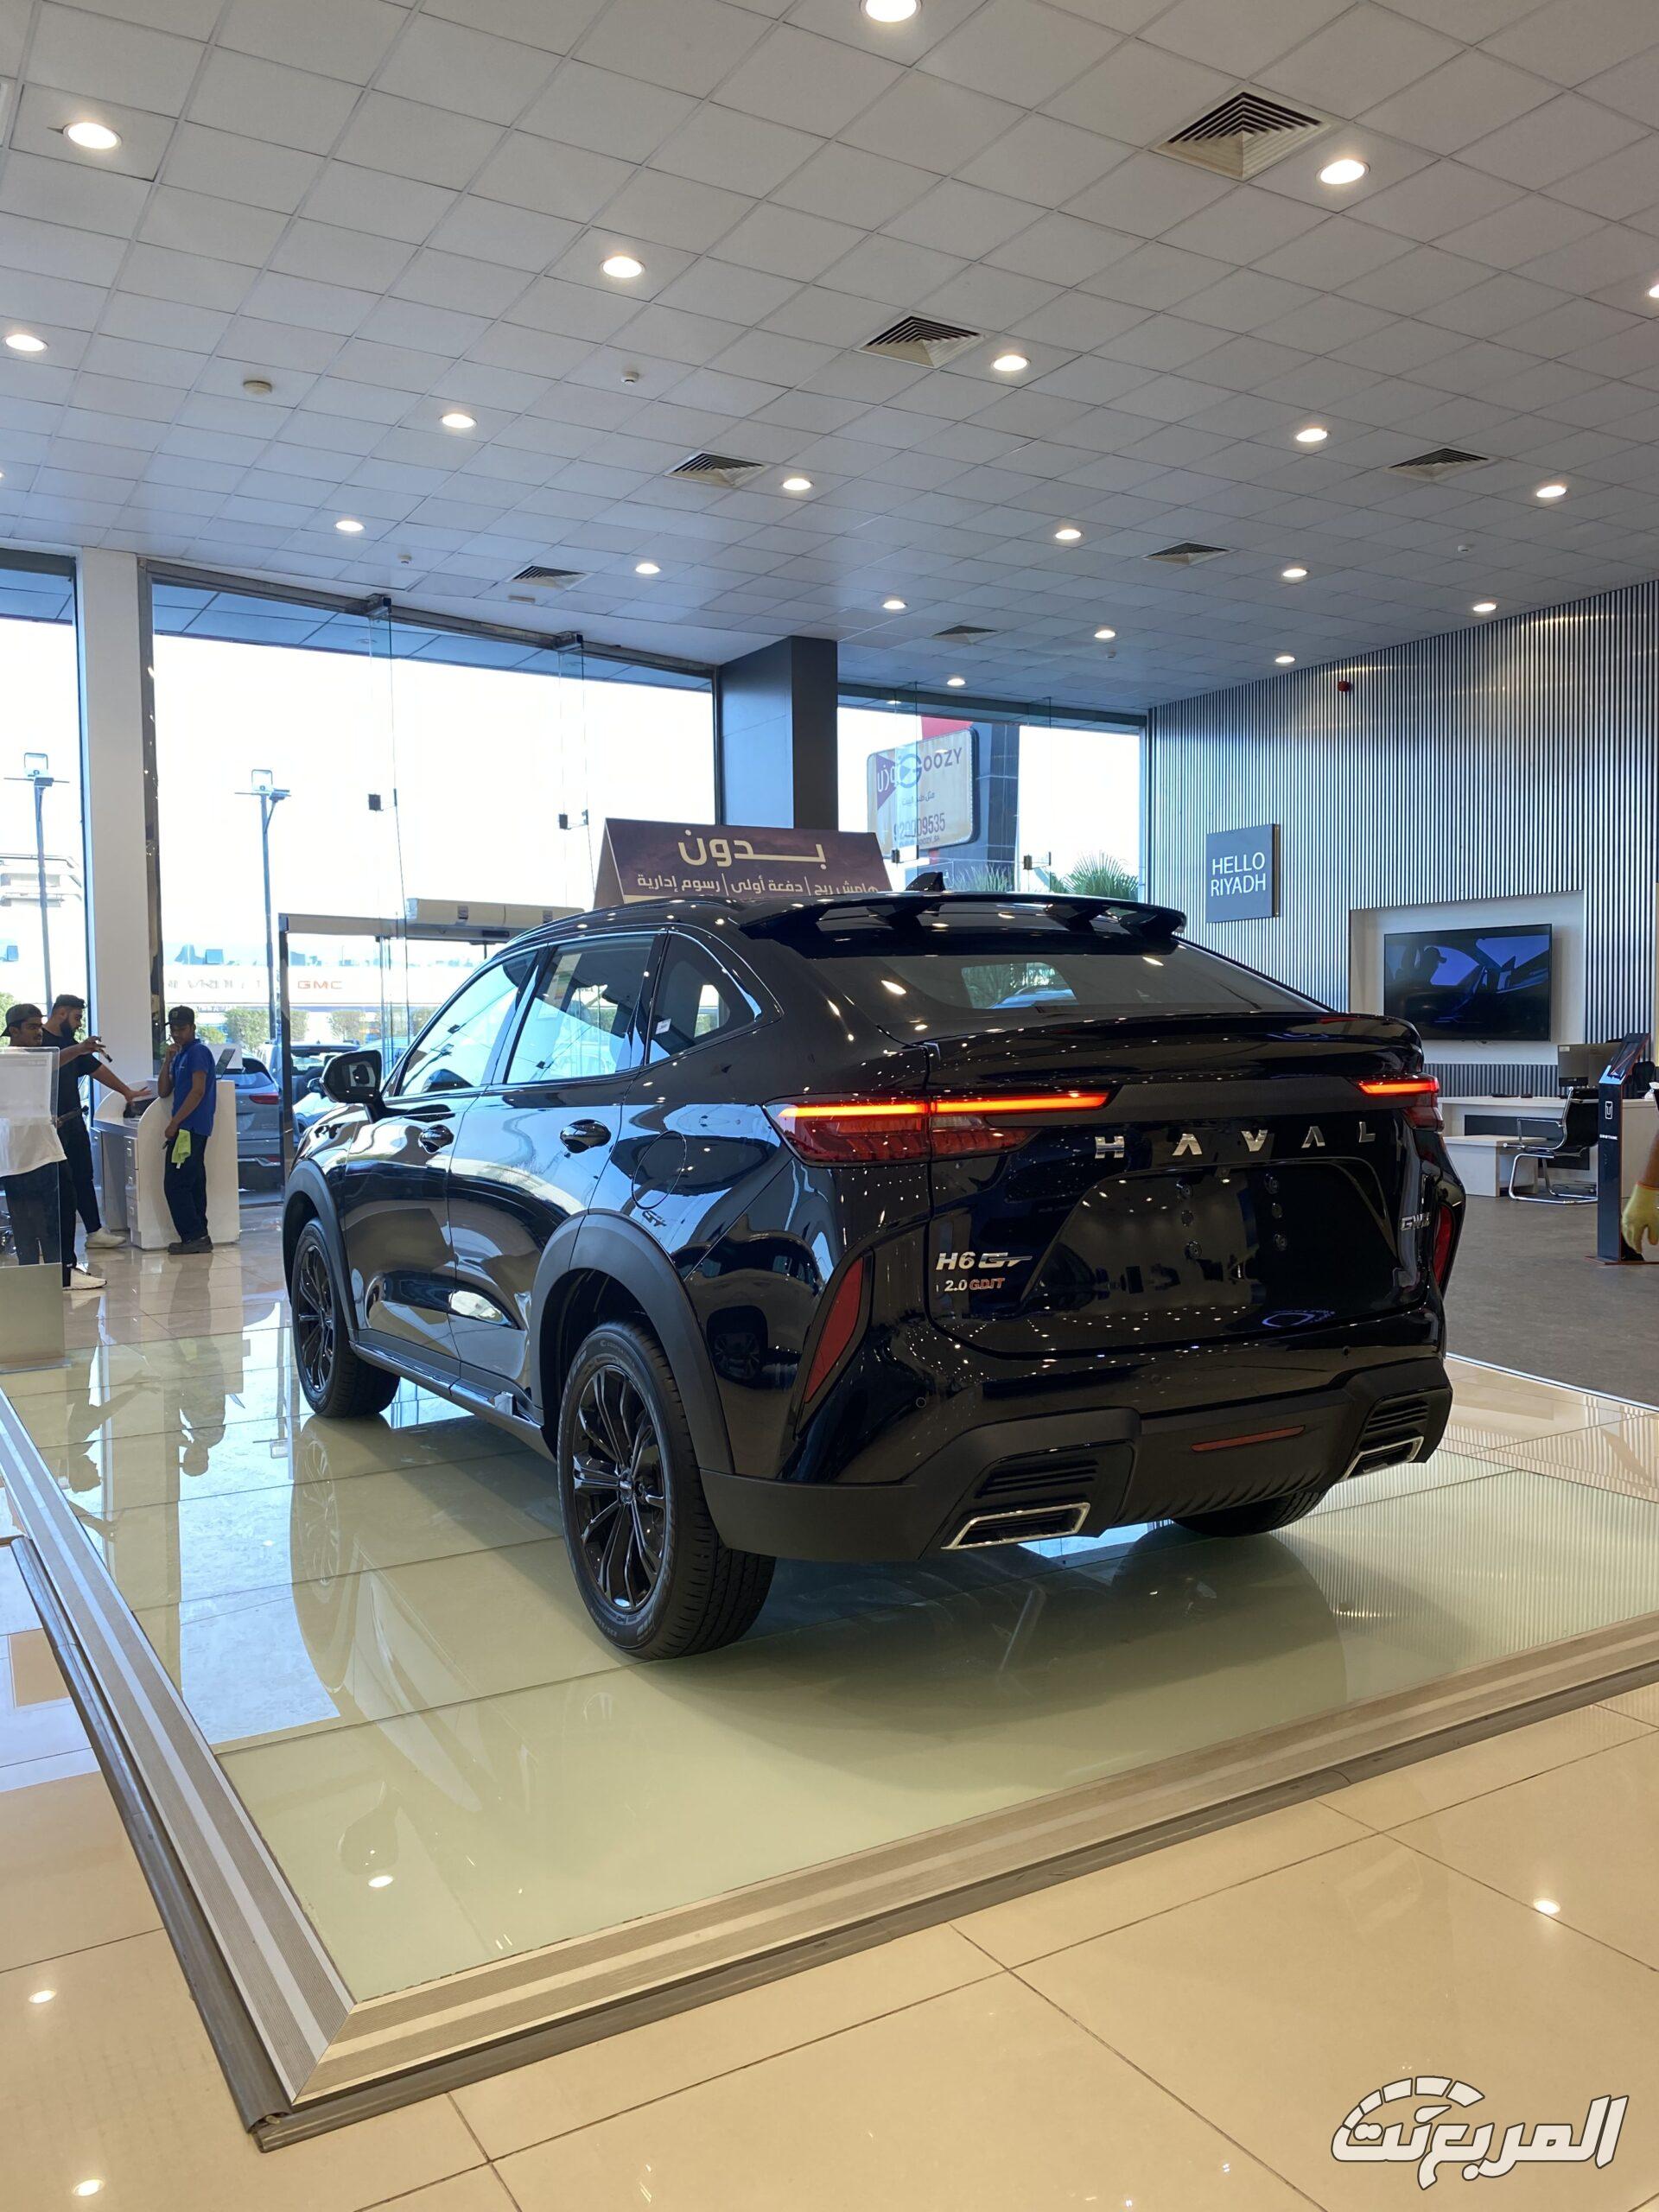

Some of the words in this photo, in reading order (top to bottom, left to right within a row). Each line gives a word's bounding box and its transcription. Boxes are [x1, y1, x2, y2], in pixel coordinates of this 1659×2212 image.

[677, 829, 827, 870] بدون
[1212, 852, 1265, 876] HELLO
[638, 874, 678, 893] إدارية
[682, 878, 720, 893] رسوم
[731, 874, 765, 894] أولى
[767, 879, 804, 893] دفعة
[1211, 873, 1266, 897] RIYADH
[297, 980, 343, 989] GMC
[1094, 1121, 1376, 1160] HAVAL
[935, 1251, 976, 1270] H6
[944, 1279, 968, 1292] 2.0
